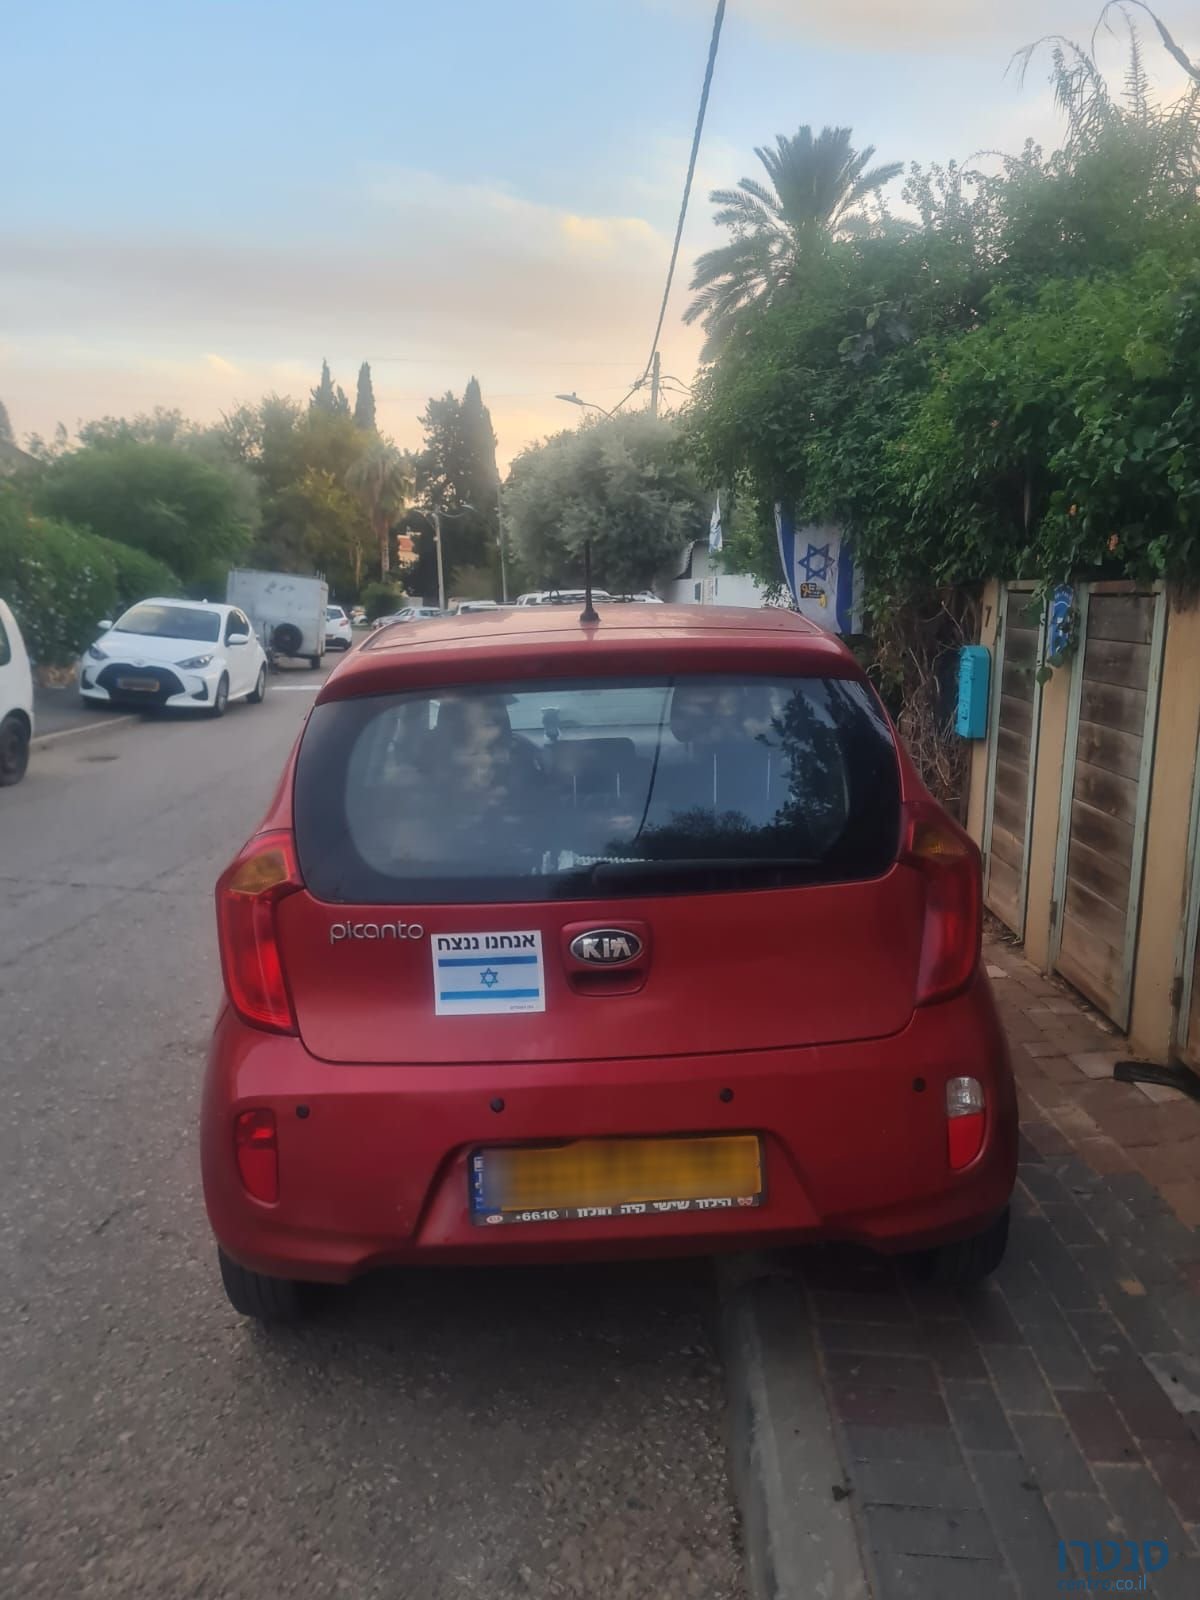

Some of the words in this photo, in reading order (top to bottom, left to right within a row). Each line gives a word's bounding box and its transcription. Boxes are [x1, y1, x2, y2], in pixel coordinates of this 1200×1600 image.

[330, 920, 424, 945] picanto
[437, 936, 480, 952] ננצח
[485, 933, 536, 949] אנחנו
[582, 936, 632, 959] KIA
[620, 1203, 646, 1214] קיה
[653, 1200, 690, 1211] שישי
